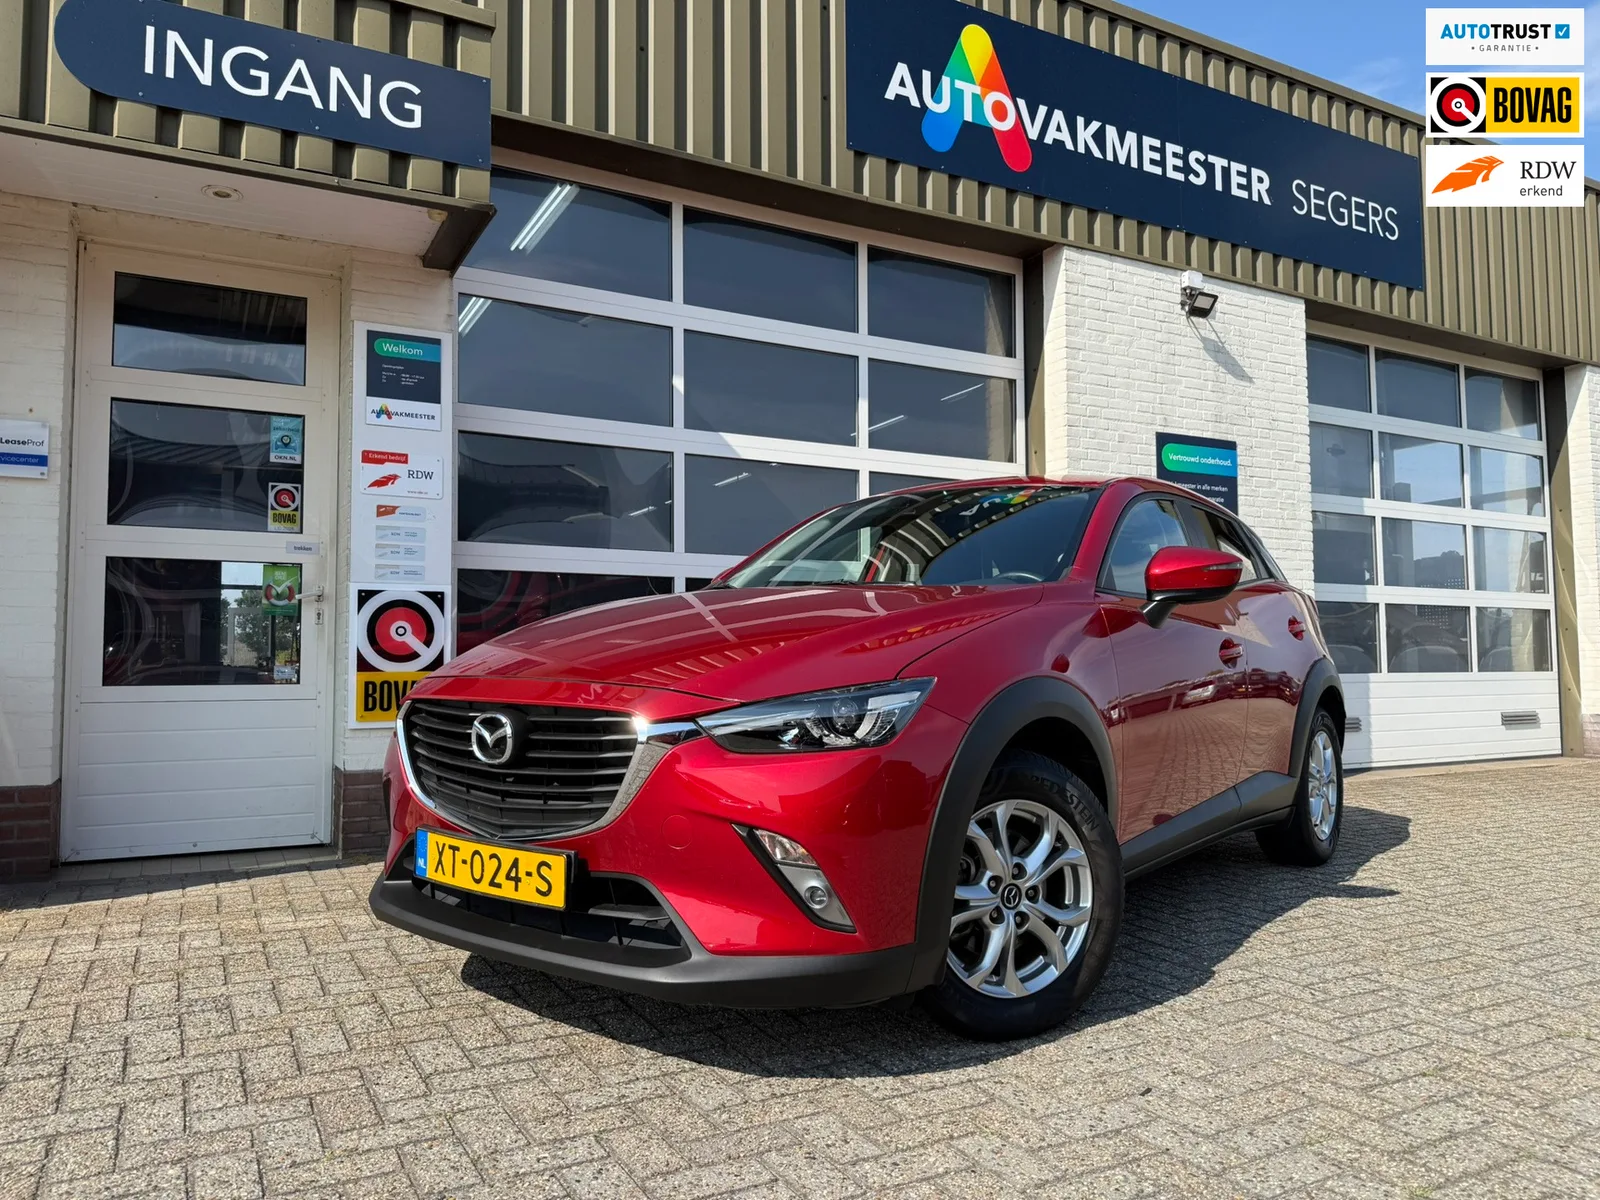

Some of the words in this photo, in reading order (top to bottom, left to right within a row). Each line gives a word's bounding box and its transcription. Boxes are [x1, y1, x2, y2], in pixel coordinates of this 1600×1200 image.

[144, 25, 422, 128] INGANG
[884, 62, 1271, 206] AUTOVAKMEESTER
[1291, 179, 1399, 241] SEGERS
[382, 343, 423, 356] Welkom
[371, 408, 436, 420] AUTOVAKMEESTER
[0, 455, 39, 463] vicecenter
[1168, 453, 1200, 462] Vertrouwd
[1200, 457, 1233, 466] onderhoud.
[407, 469, 434, 480] RDW
[272, 512, 297, 524] BOVAG
[418, 857, 426, 868] NL
[434, 841, 553, 897] XT-024-S
